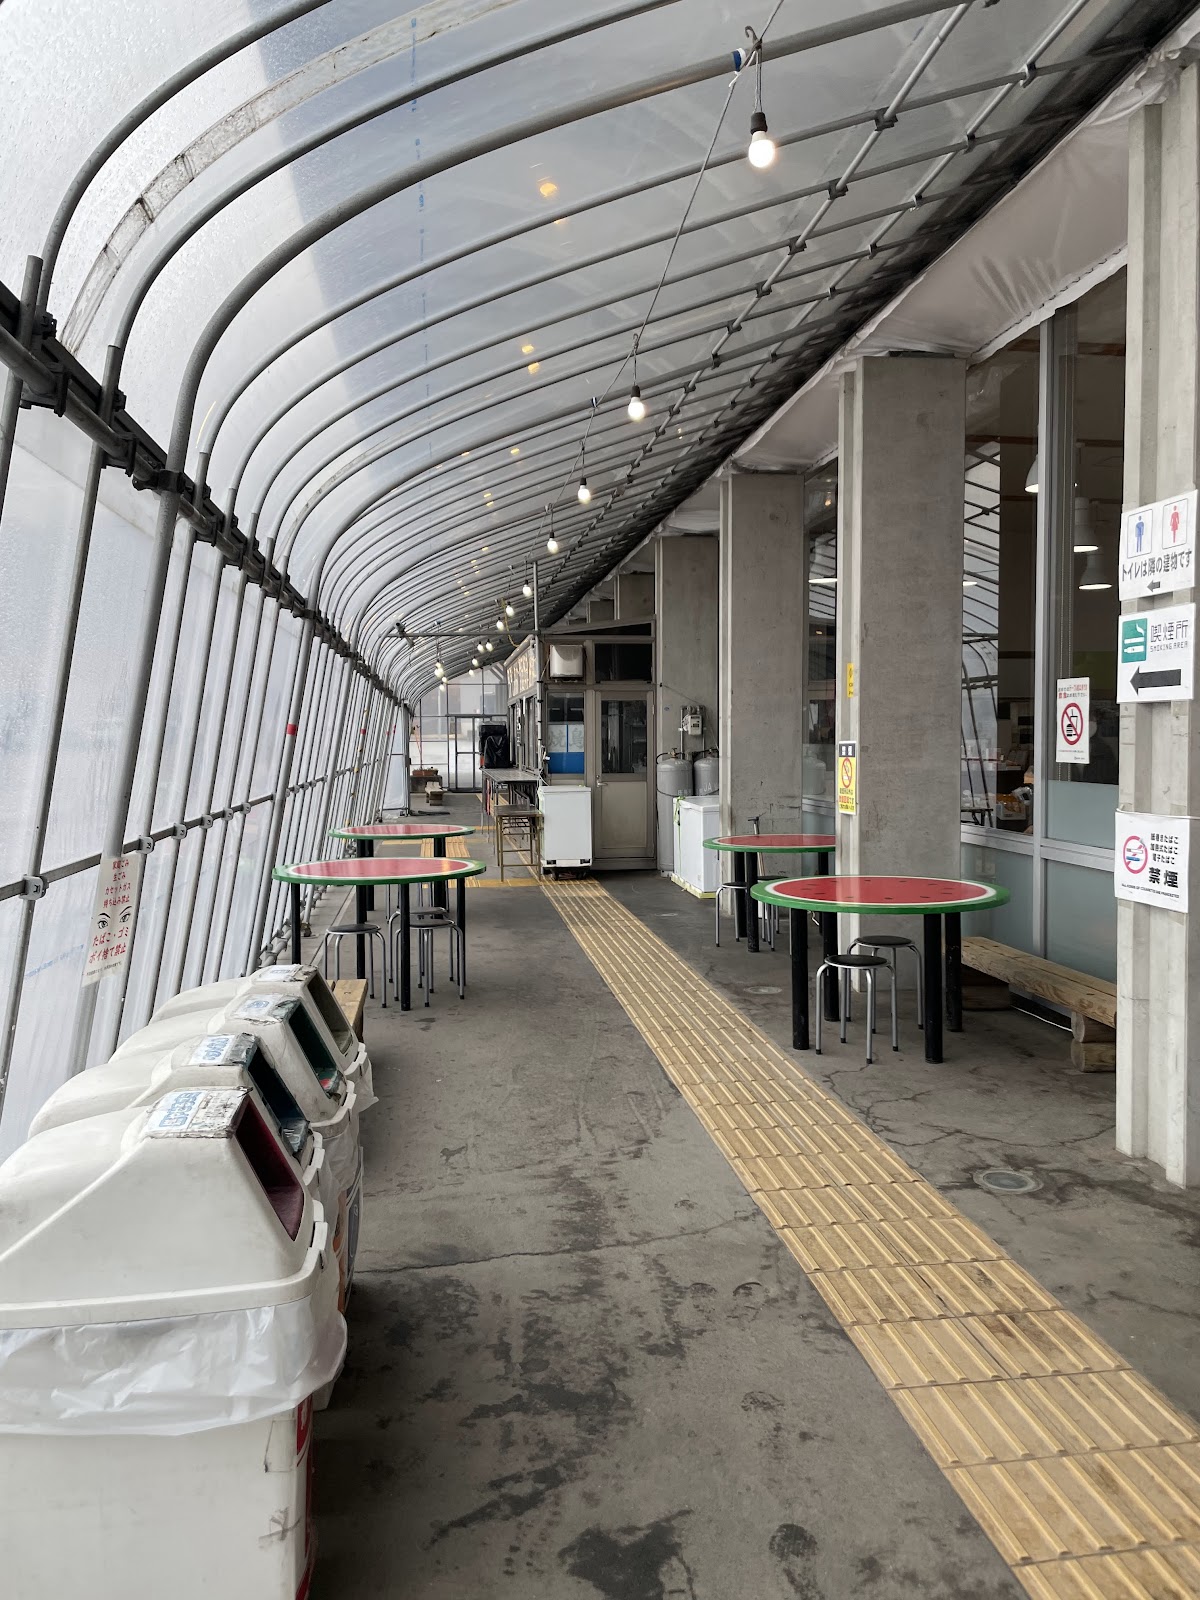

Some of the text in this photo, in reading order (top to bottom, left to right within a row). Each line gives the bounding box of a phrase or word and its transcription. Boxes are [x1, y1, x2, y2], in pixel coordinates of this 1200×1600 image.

[1122, 549, 1192, 582] トイレは隣の建物です
[1150, 619, 1189, 643] 喫煙所
[1149, 641, 1188, 653] SMOKING AREA
[1148, 866, 1179, 889] 禁煙
